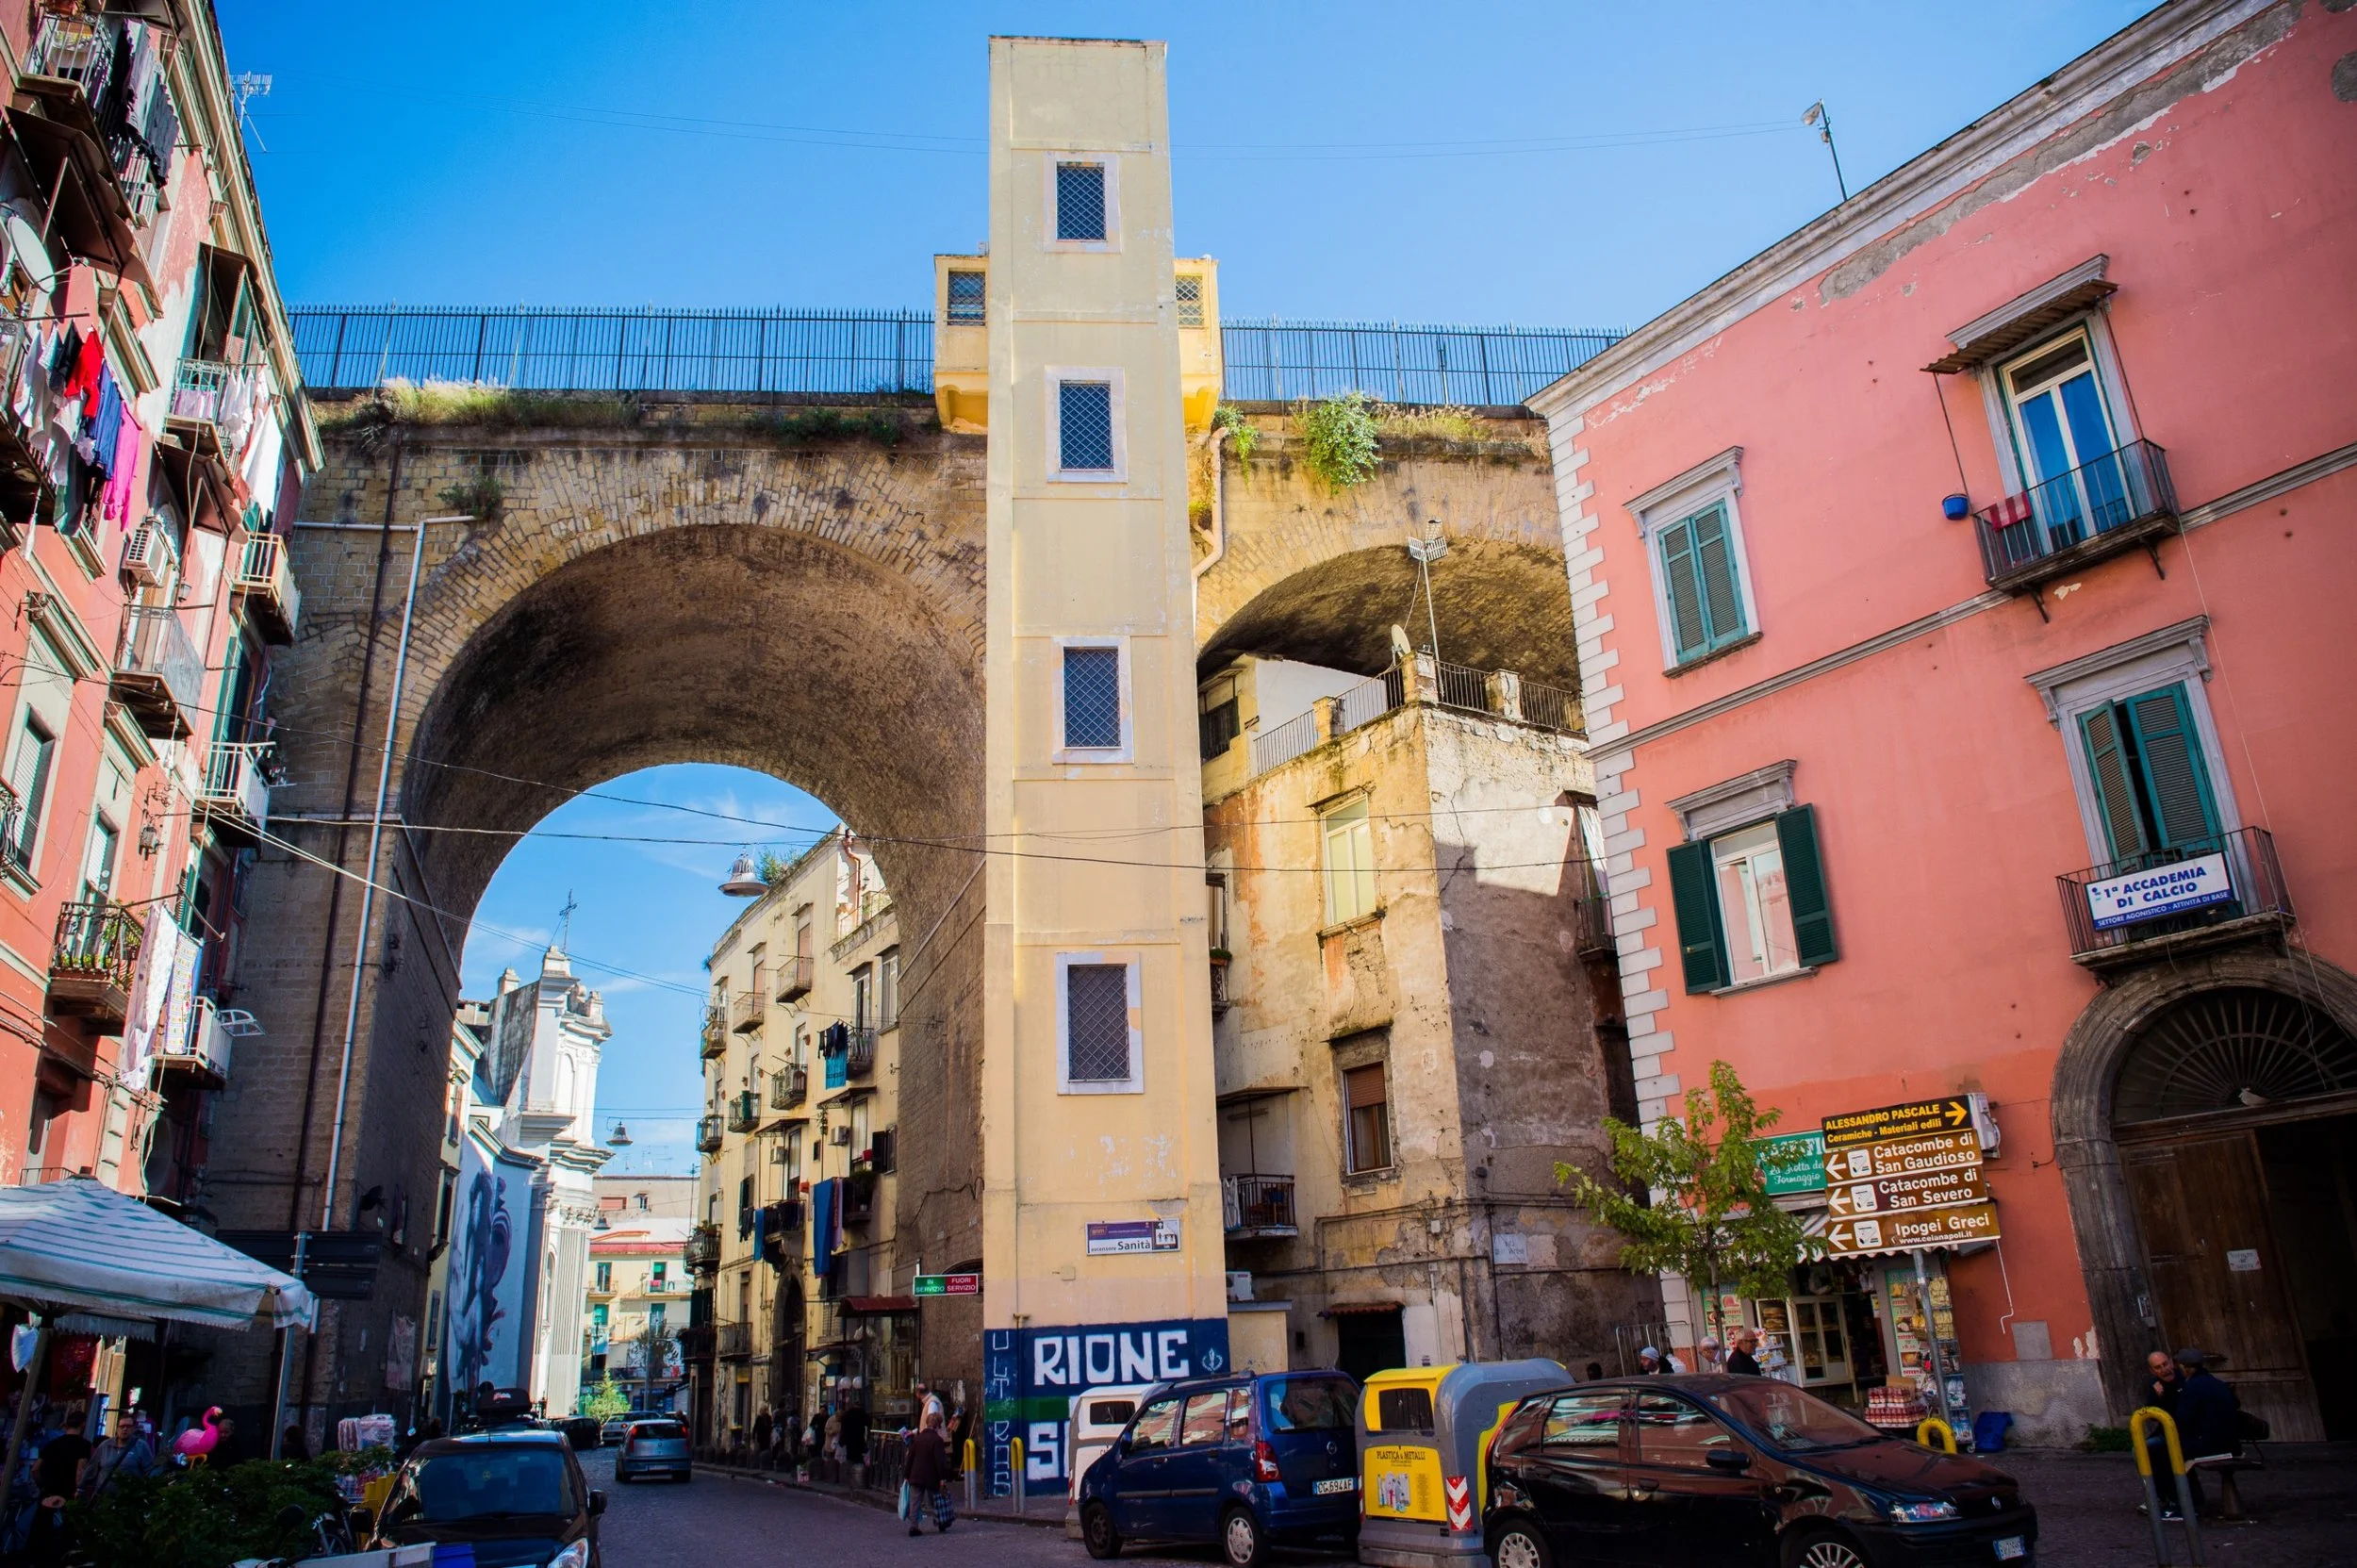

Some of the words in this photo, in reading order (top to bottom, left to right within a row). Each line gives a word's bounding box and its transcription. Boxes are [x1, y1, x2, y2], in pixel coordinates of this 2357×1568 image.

[2123, 867, 2207, 894] ACCADEMIA
[2117, 897, 2134, 908] DI
[2143, 882, 2198, 901] CALCIO
[2098, 915, 2124, 927] SETTORE
[2126, 906, 2167, 920] AGONISTICO
[2211, 891, 2229, 900] BASE
[1825, 1112, 1889, 1131] ALESSANDRO
[1891, 1103, 1940, 1120] PASCALE
[1827, 1130, 1872, 1143] Ceramiche
[1879, 1121, 1919, 1135] Materiali
[1920, 1117, 1942, 1130] edili
[1873, 1137, 1953, 1159] Catacombe
[1959, 1132, 1974, 1146] di
[1875, 1160, 1902, 1174] San
[1904, 1150, 1975, 1170] Gaudioso
[1773, 1173, 1821, 1186] Formaggio
[1879, 1173, 1958, 1195] Catacombe
[1964, 1168, 1978, 1181] di
[1889, 1195, 1917, 1208] San
[1922, 1188, 1972, 1204] Severo
[1895, 1218, 1942, 1237] Ipogei
[1948, 1213, 1990, 1230] Greci
[1899, 1230, 1973, 1245] www.celanapoli.it
[1117, 1240, 1151, 1251] Sanità
[1033, 1330, 1190, 1386] RIONE
[1376, 1450, 1399, 1461] PLASTICA
[1404, 1450, 1426, 1461] METALLI
